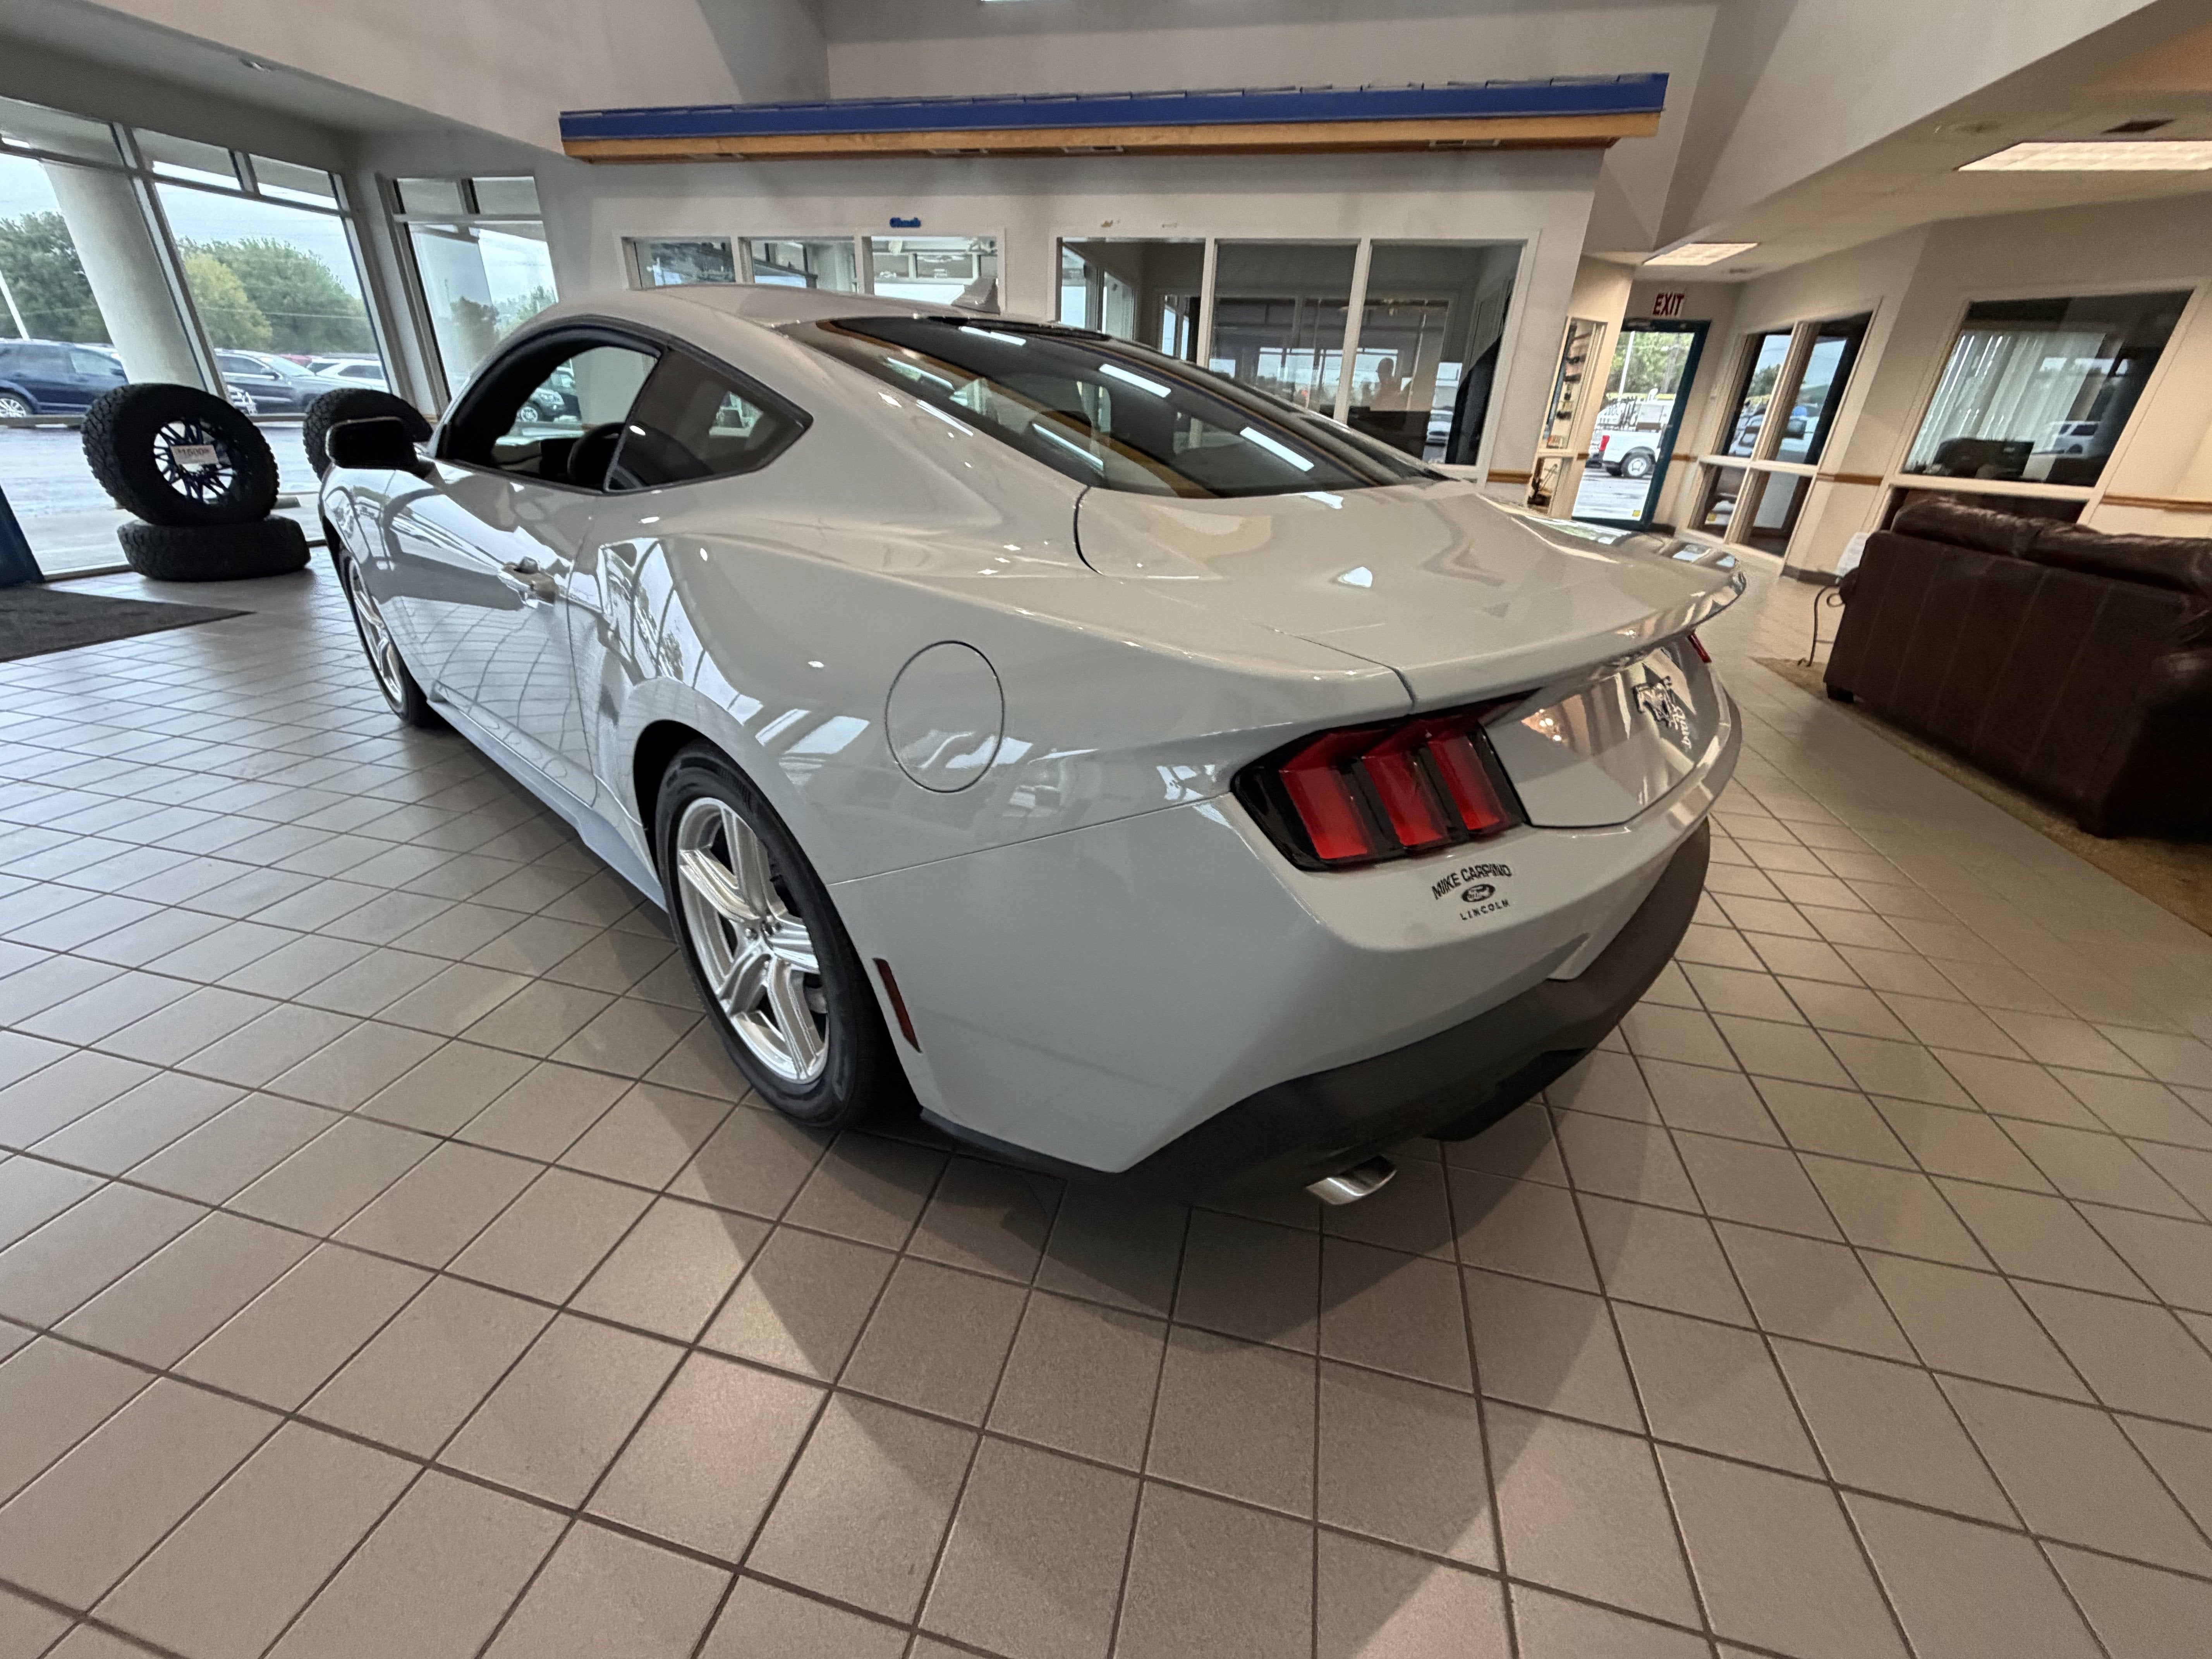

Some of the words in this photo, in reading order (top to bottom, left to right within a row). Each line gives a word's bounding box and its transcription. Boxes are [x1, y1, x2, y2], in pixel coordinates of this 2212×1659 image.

[1652, 292, 1685, 316] EXIT
[1432, 872, 1462, 900] MIKE
[1460, 863, 1512, 882] CARPINO
[1460, 899, 1510, 920] LINCOLN
